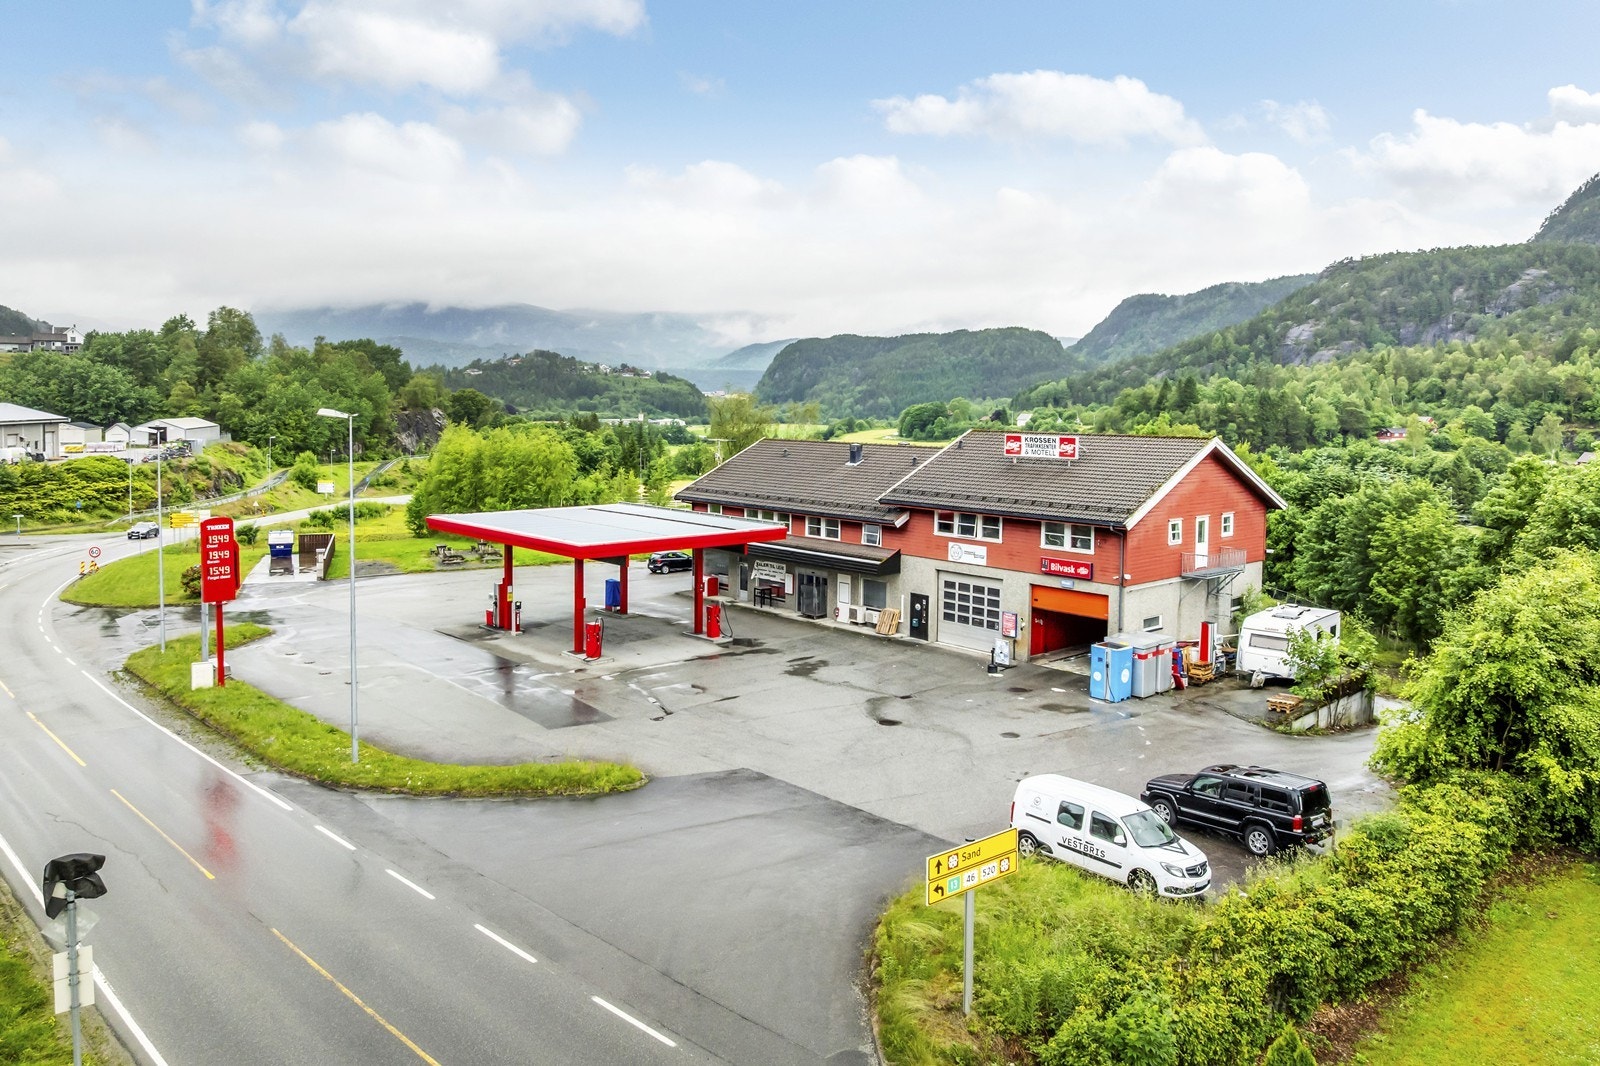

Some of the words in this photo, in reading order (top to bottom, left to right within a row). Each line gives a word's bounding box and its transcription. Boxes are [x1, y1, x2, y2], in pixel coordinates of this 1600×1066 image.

[1050, 562, 1076, 574] Bilvask
[961, 847, 981, 862] Sand
[1061, 836, 1106, 858] VESTBRIS
[966, 873, 976, 882] 46
[982, 865, 996, 877] 520
